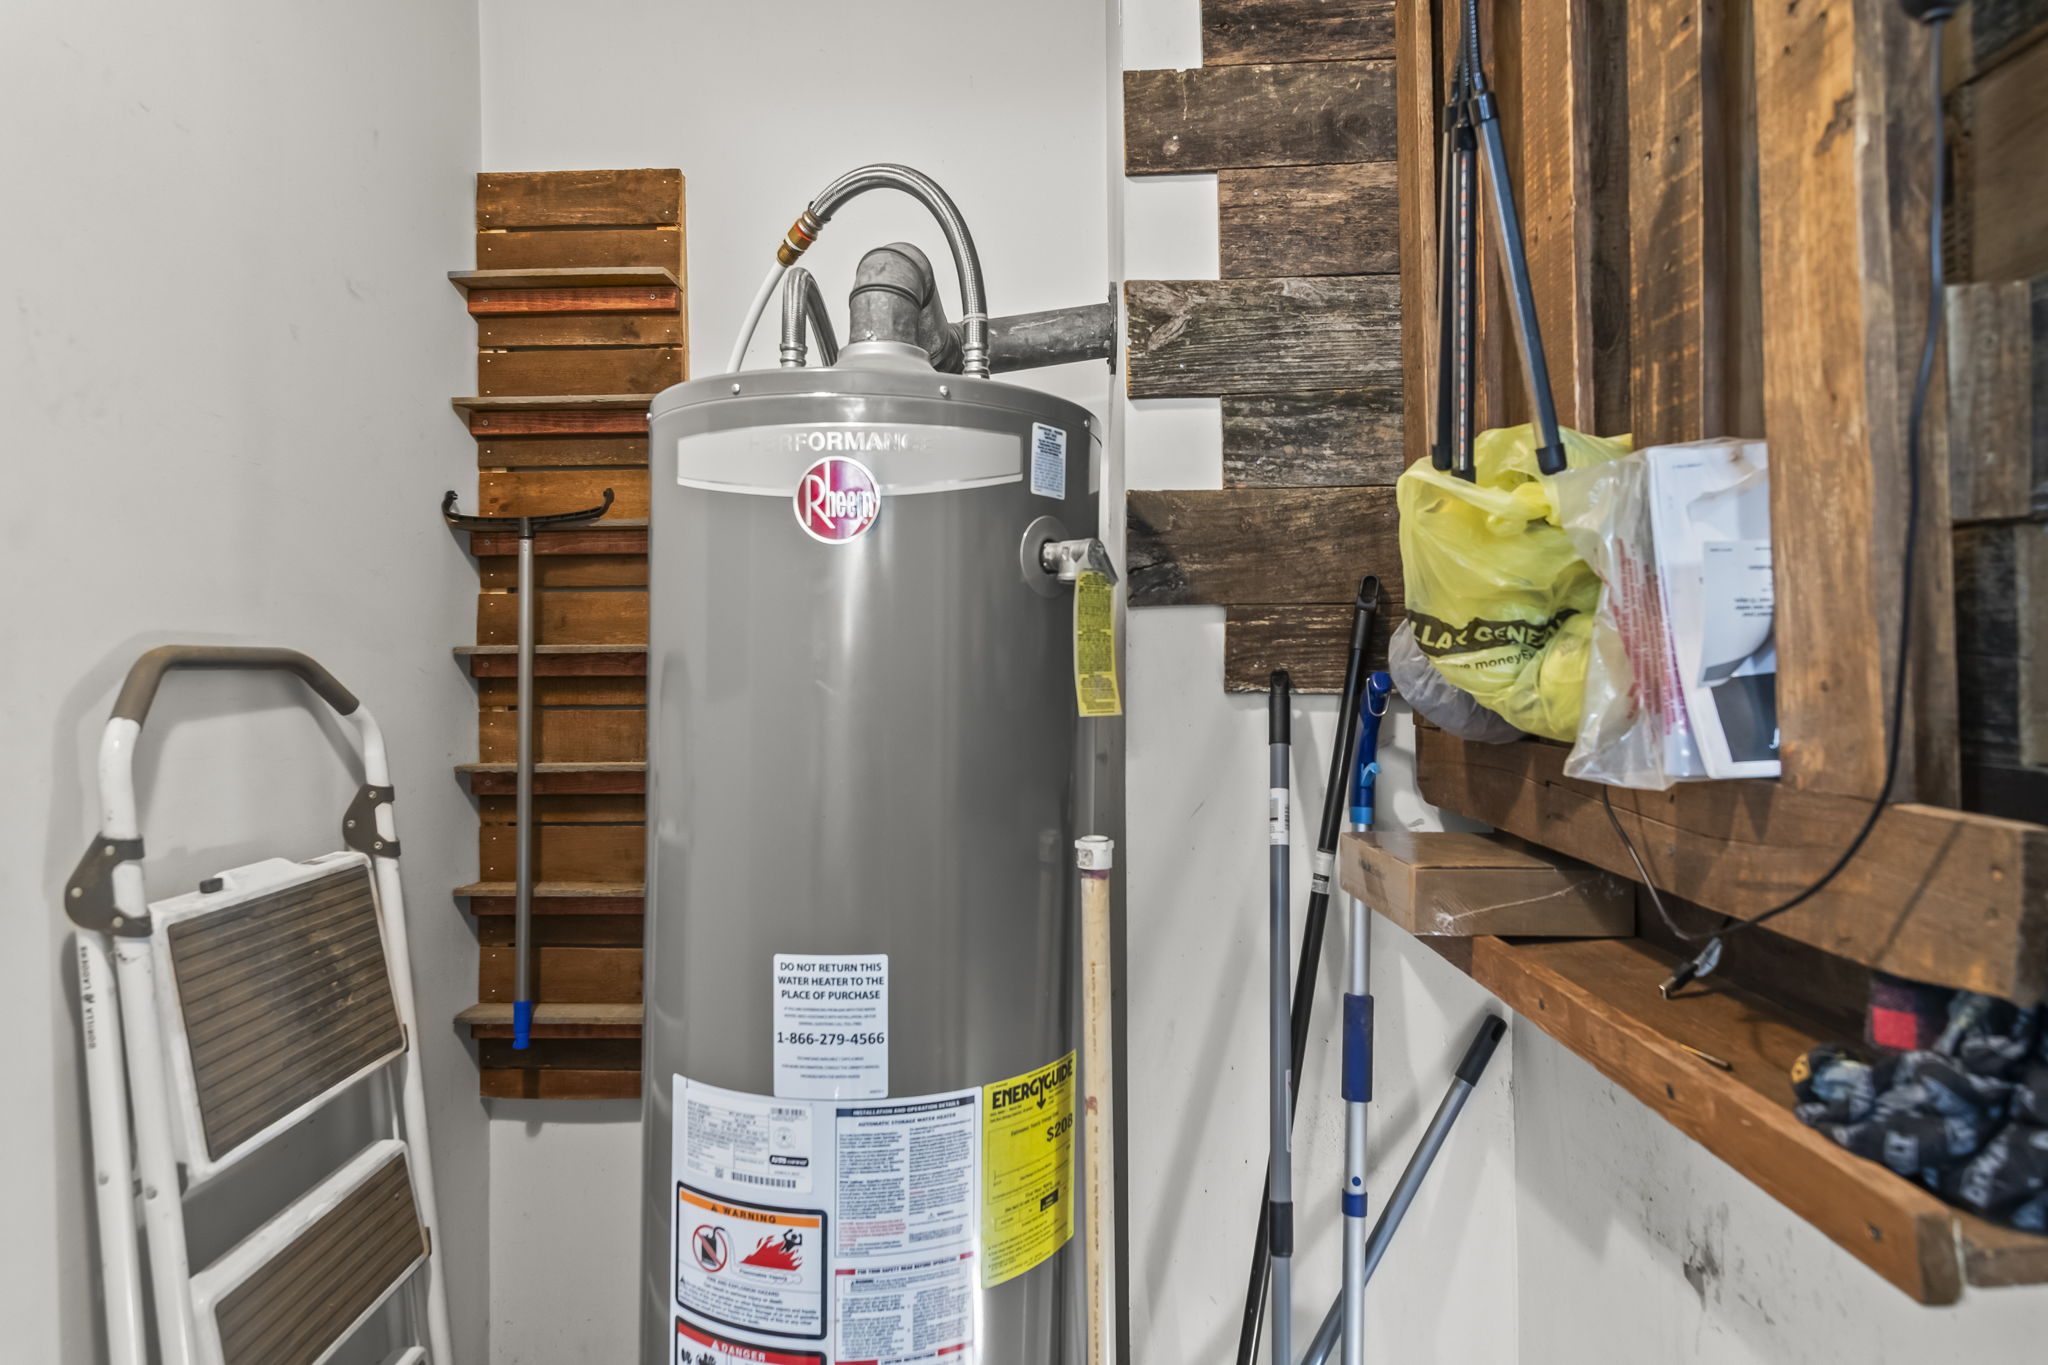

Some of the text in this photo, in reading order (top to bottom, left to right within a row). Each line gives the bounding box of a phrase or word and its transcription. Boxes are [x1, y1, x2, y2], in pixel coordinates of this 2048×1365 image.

[780, 962, 882, 972] DO NOT RETURN THIS
[778, 976, 885, 986] WATER HEATER TO THE
[80, 946, 97, 1050] GORILLA LADDERS
[781, 990, 880, 1000] PLACE OF PURCHASE
[777, 1032, 885, 1045] 1-866-279-4566
[992, 1059, 1073, 1110] ENERGYGUIDE
[724, 1207, 777, 1224] WARNING
[721, 1342, 766, 1362] DANGER
